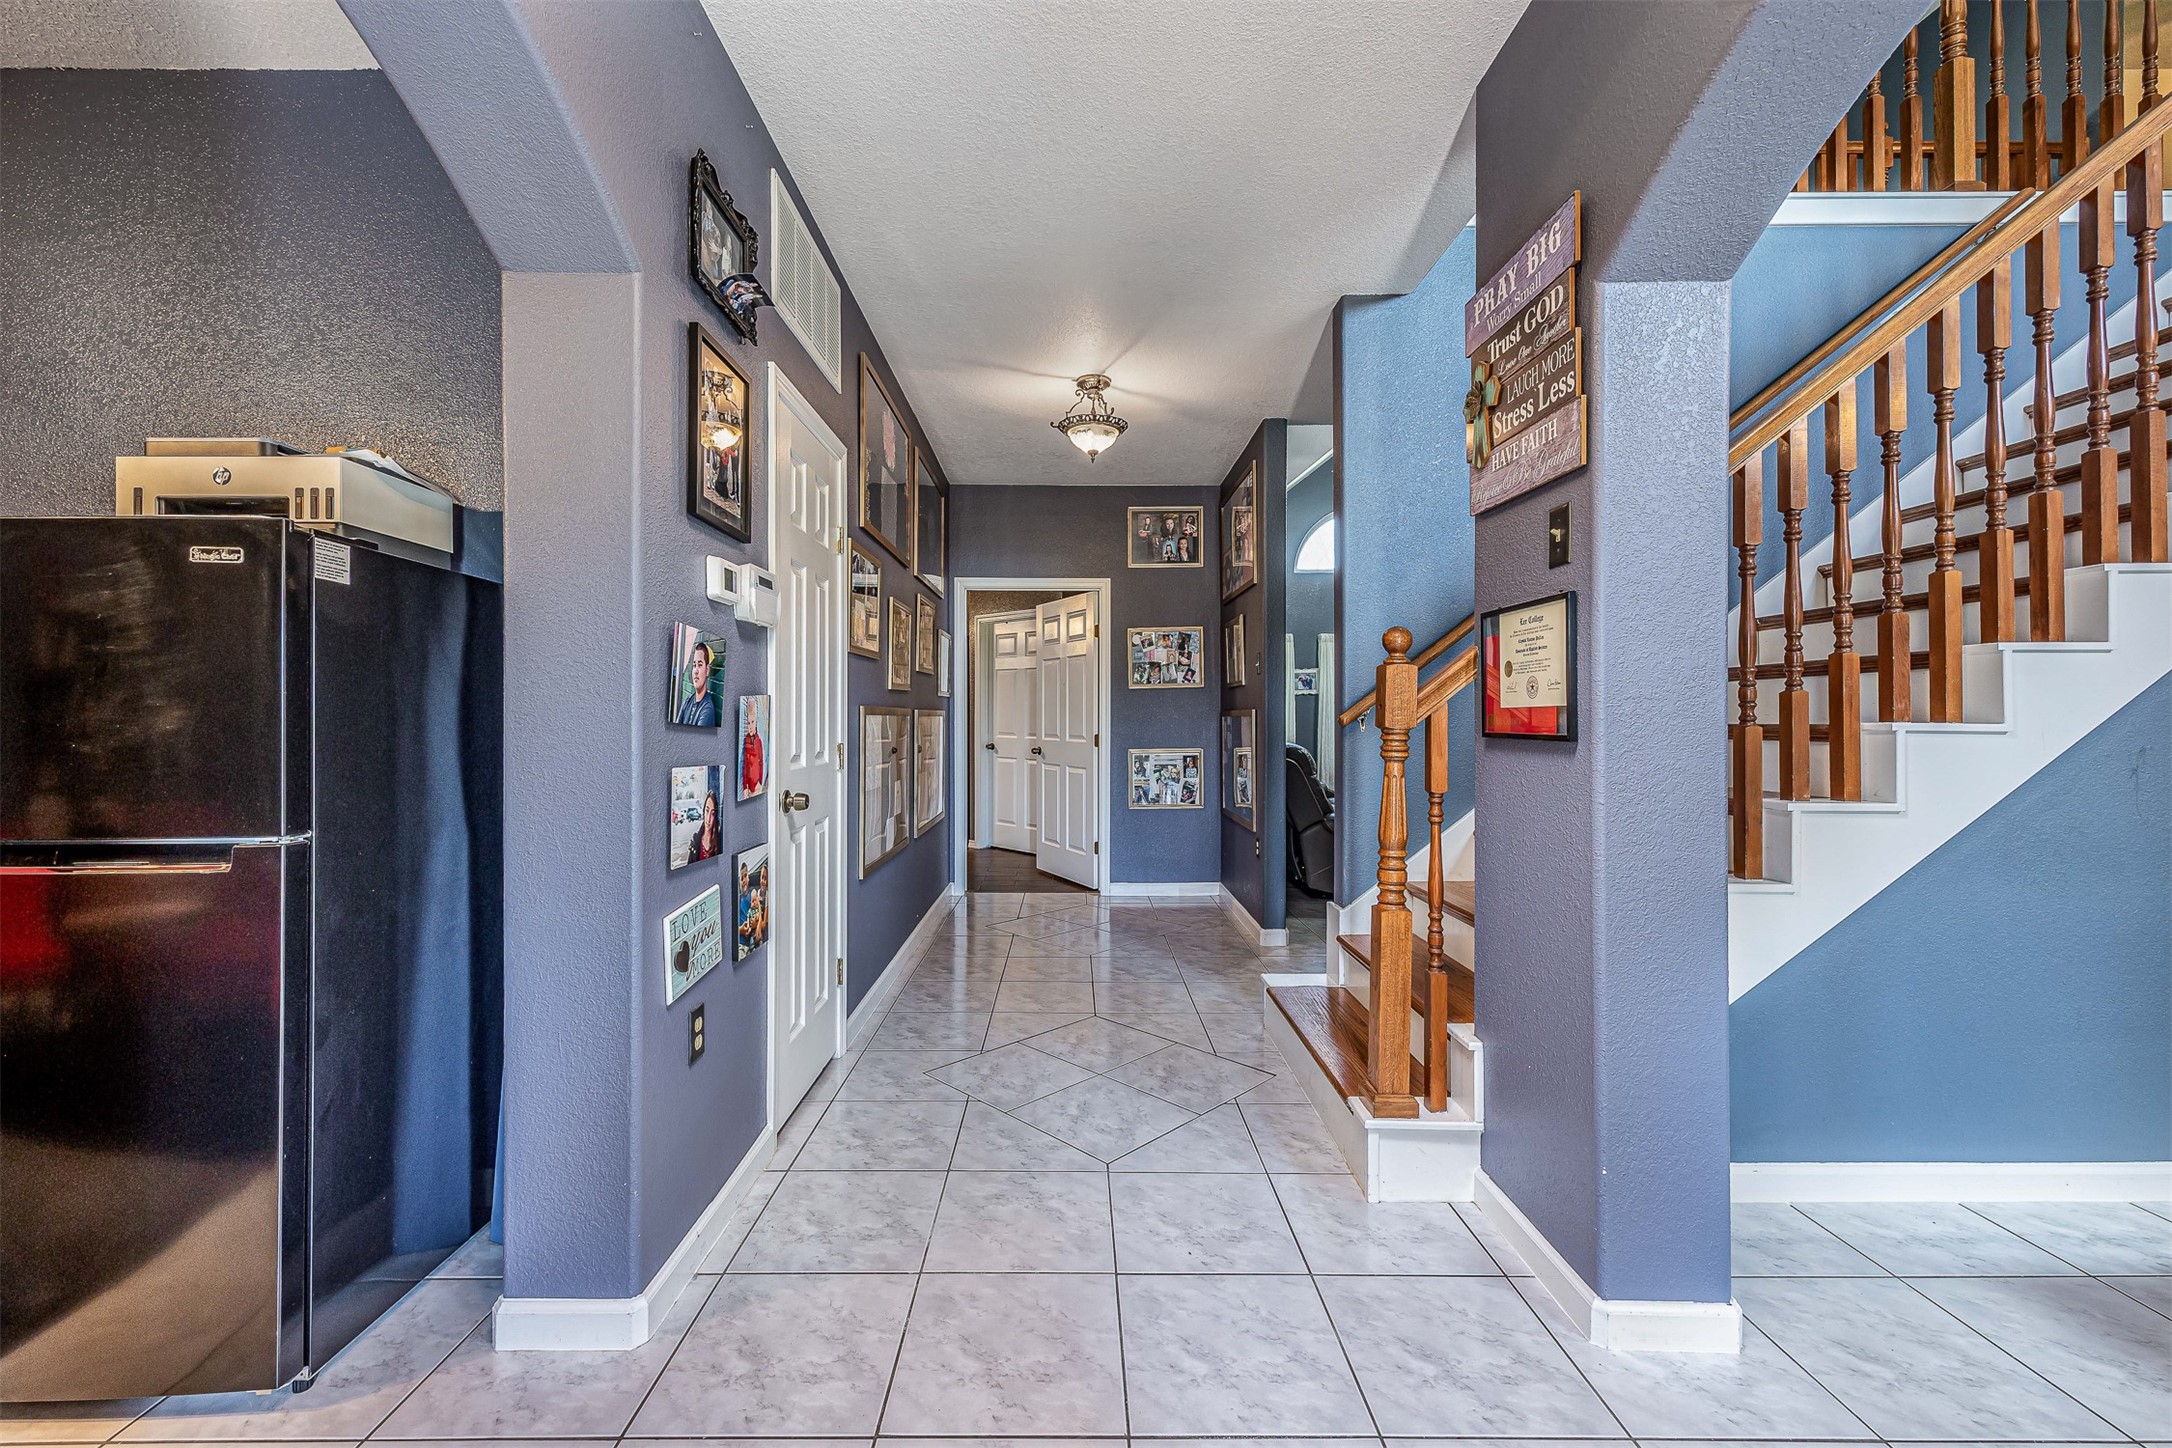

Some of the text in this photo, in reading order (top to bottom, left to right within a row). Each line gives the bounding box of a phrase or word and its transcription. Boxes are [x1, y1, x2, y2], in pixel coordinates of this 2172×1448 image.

[1473, 219, 1562, 328] PRAY BIG
[1486, 270, 1543, 333] Worry Small
[1487, 284, 1564, 365] Trust GOD
[1498, 357, 1517, 376] Love
[1507, 337, 1575, 404] LAUGH MORE
[1492, 370, 1575, 439] Stress Less
[1491, 418, 1558, 473] HAVE FAITH
[1533, 436, 1580, 481] Grateful
[214, 467, 231, 485] hp
[672, 901, 708, 942] LOVE
[688, 920, 717, 975] you
[690, 942, 721, 979] MORE
